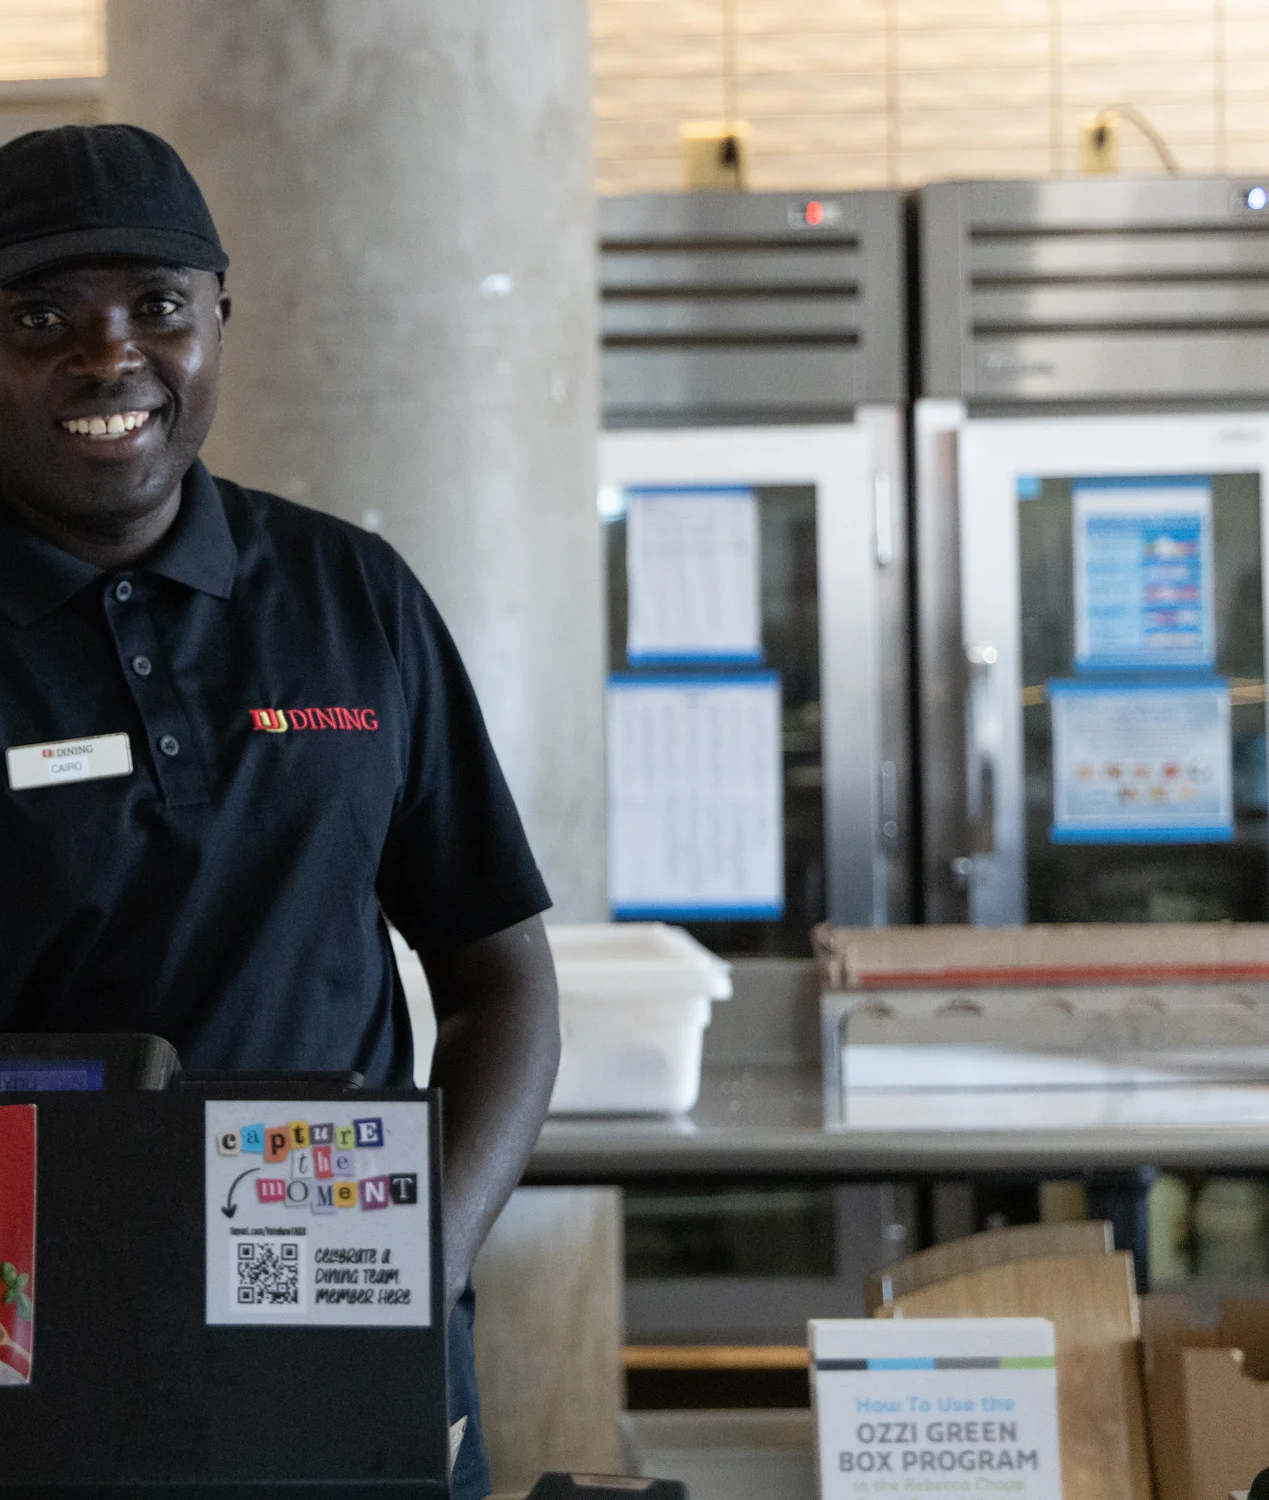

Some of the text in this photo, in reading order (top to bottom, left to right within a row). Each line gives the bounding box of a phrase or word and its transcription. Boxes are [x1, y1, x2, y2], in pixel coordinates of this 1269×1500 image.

[287, 706, 379, 732] DINING
[56, 744, 94, 758] DINING
[51, 761, 83, 774] CAIRO
[297, 1151, 349, 1174] the
[856, 1396, 1015, 1412] How To Use the
[856, 1421, 1018, 1444] OZZI GREEN
[839, 1449, 1040, 1472] BOX PROGRAM
[904, 1477, 970, 1491] Rebecca
